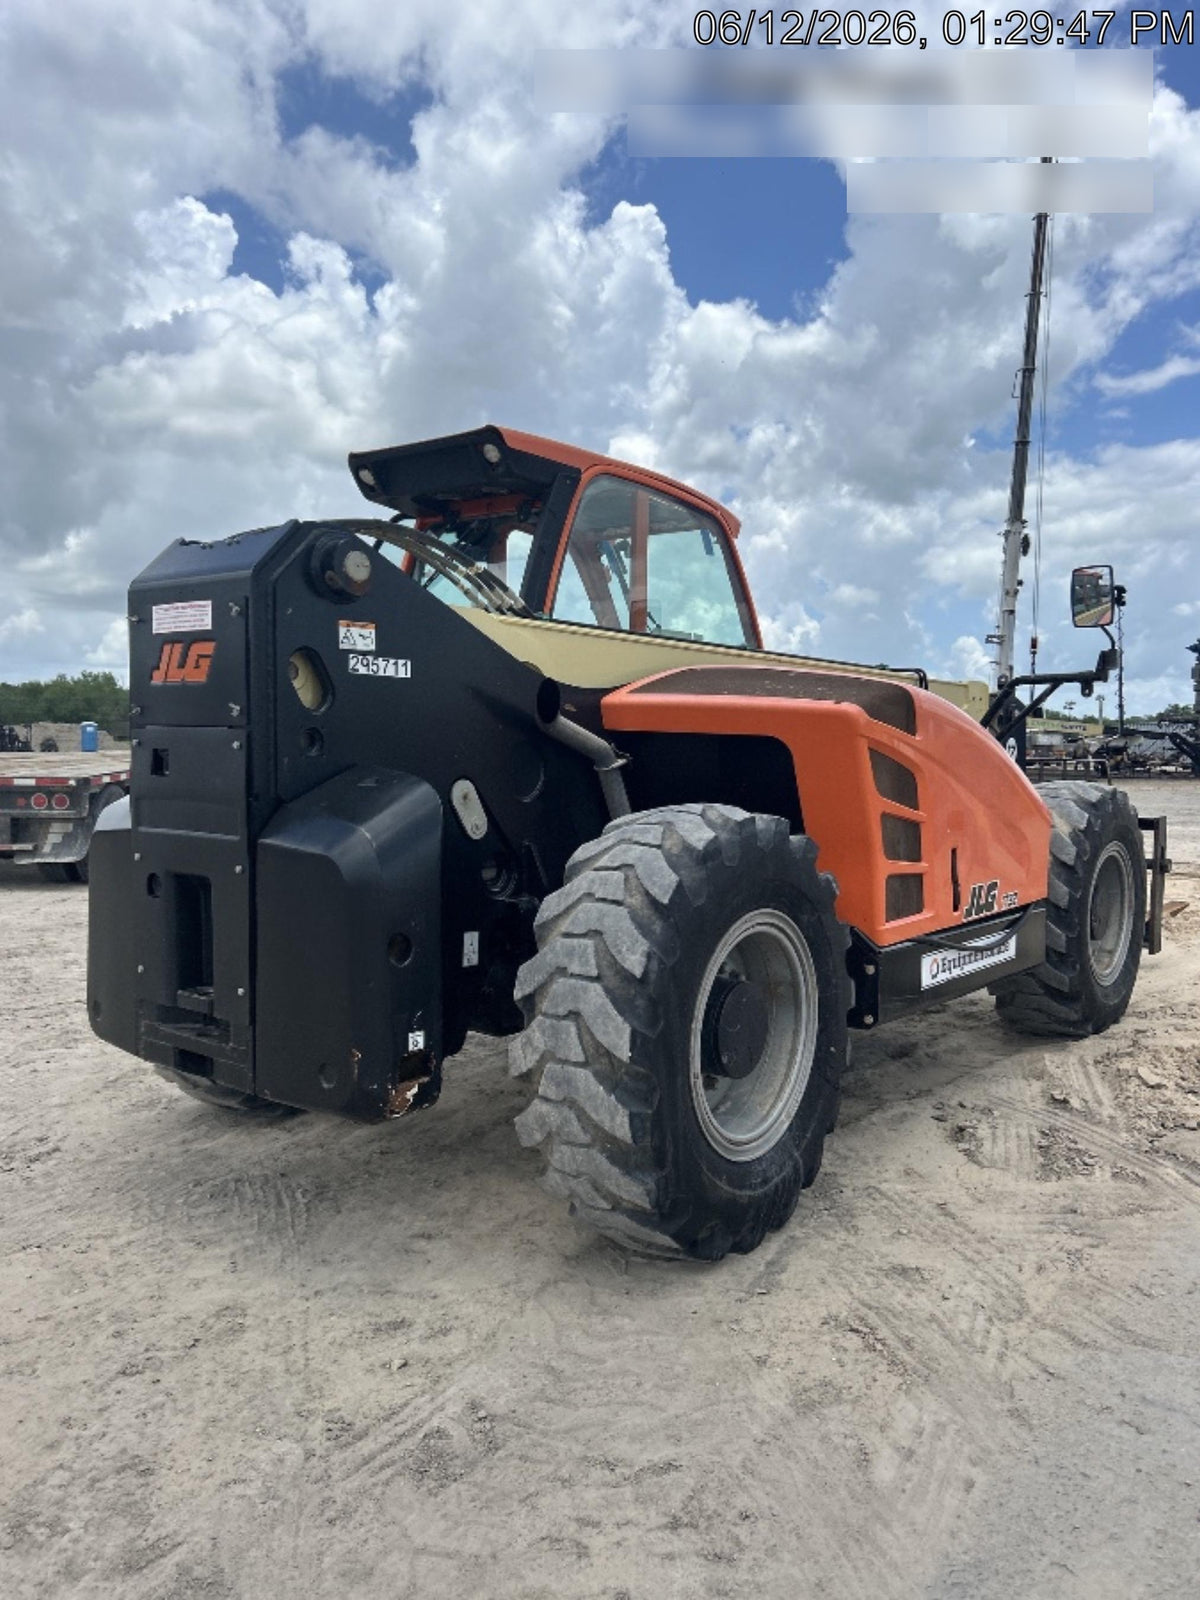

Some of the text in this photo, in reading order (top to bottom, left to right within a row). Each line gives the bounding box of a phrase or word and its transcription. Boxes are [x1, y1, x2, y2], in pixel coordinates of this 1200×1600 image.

[151, 640, 216, 684] JLG
[349, 655, 409, 677] 295711
[963, 880, 1000, 922] JLG
